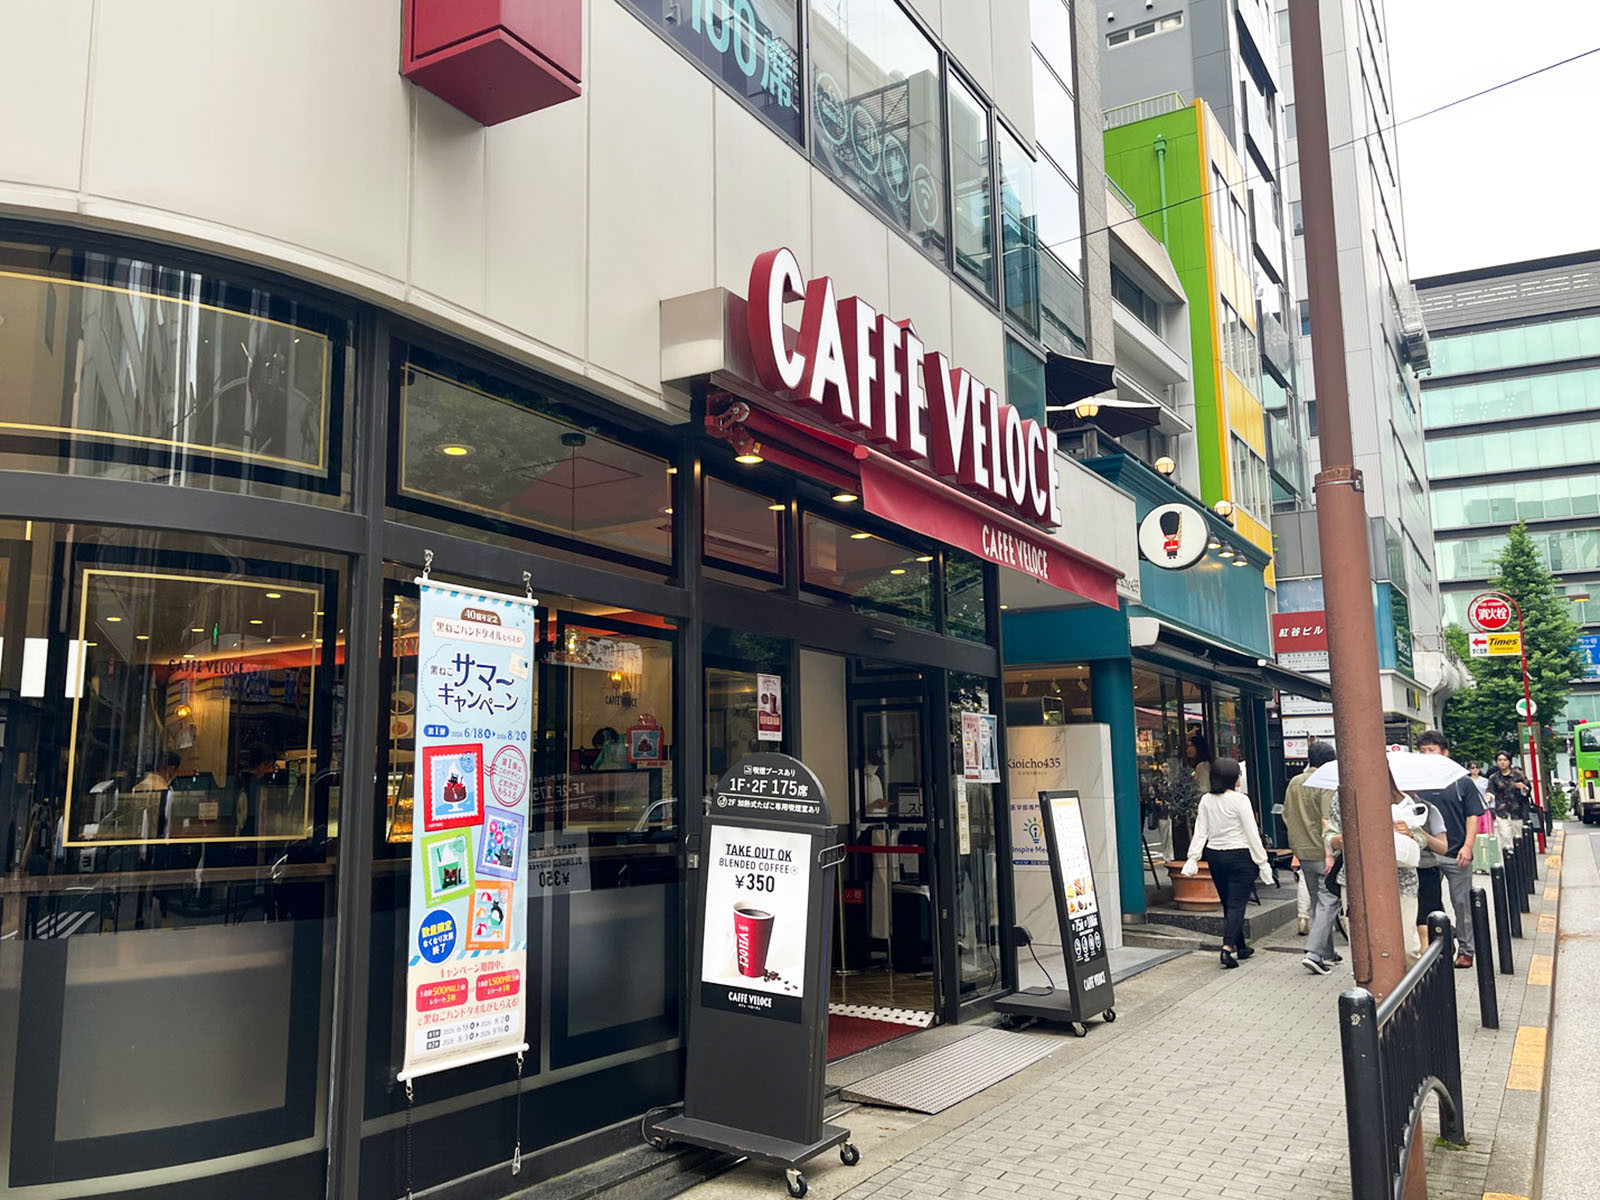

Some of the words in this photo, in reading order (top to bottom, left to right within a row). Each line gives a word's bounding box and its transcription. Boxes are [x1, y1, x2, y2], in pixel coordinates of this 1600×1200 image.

[926, 351, 1062, 528] VELOCE
[1015, 537, 1048, 580] VELOCE
[1477, 606, 1508, 621] 消火栓
[1278, 625, 1324, 639] 紅谷ビル
[1489, 638, 1519, 646] Times
[206, 662, 244, 675] VELOCE
[438, 682, 519, 716] キャンペーン
[752, 766, 796, 777] 喫煙ブースあり
[771, 779, 809, 798] 175席
[725, 843, 752, 858] TAKE
[754, 846, 776, 860] OUT
[777, 849, 793, 863] OK
[718, 857, 757, 871] BLENDED
[758, 861, 789, 874] COFFEE
[735, 872, 775, 893] ¥350
[748, 994, 773, 1008] VELOCE
